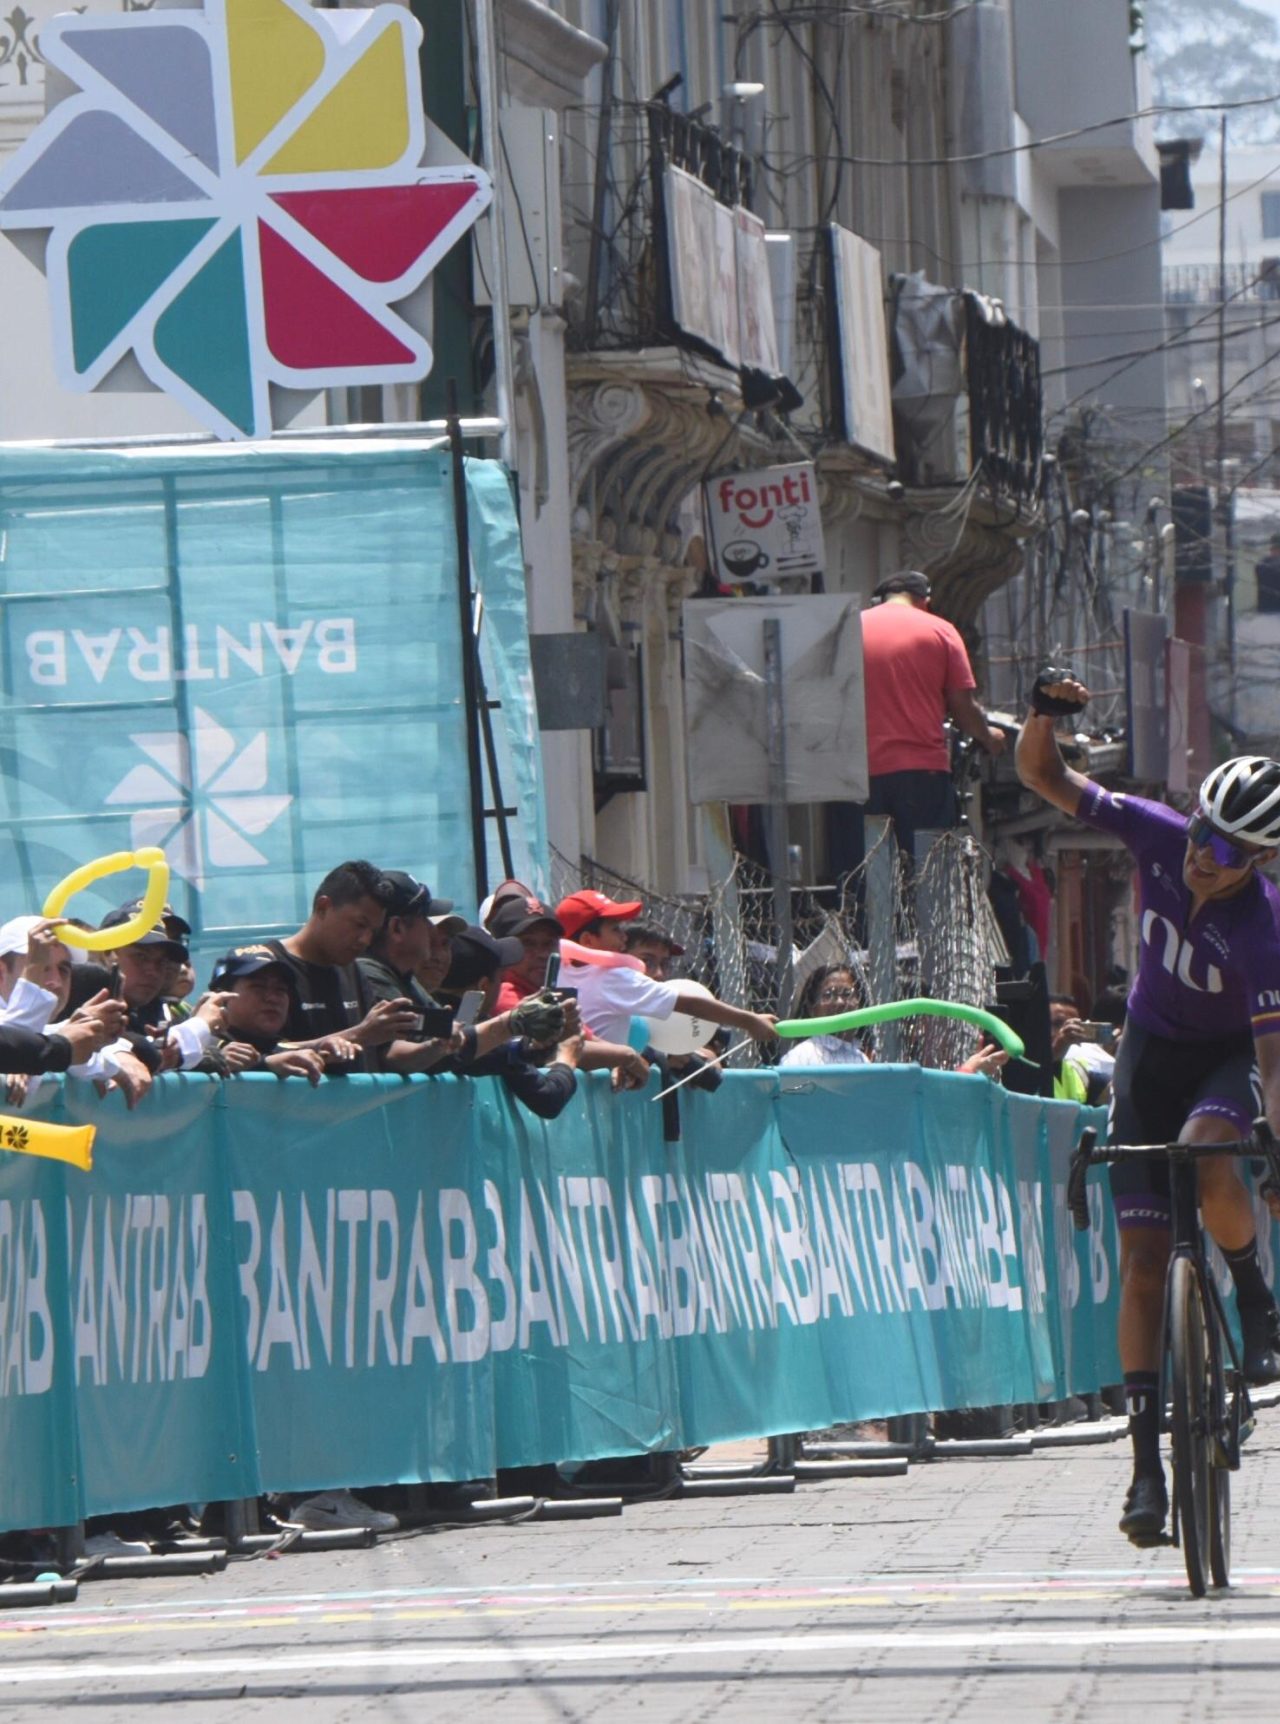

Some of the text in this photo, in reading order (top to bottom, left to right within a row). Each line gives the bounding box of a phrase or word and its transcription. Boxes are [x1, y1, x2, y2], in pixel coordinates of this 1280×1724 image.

[719, 471, 811, 513] fonti
[25, 617, 357, 686] BANTRAB
[1142, 908, 1224, 994] nu
[1120, 1208, 1169, 1221] SCOTT
